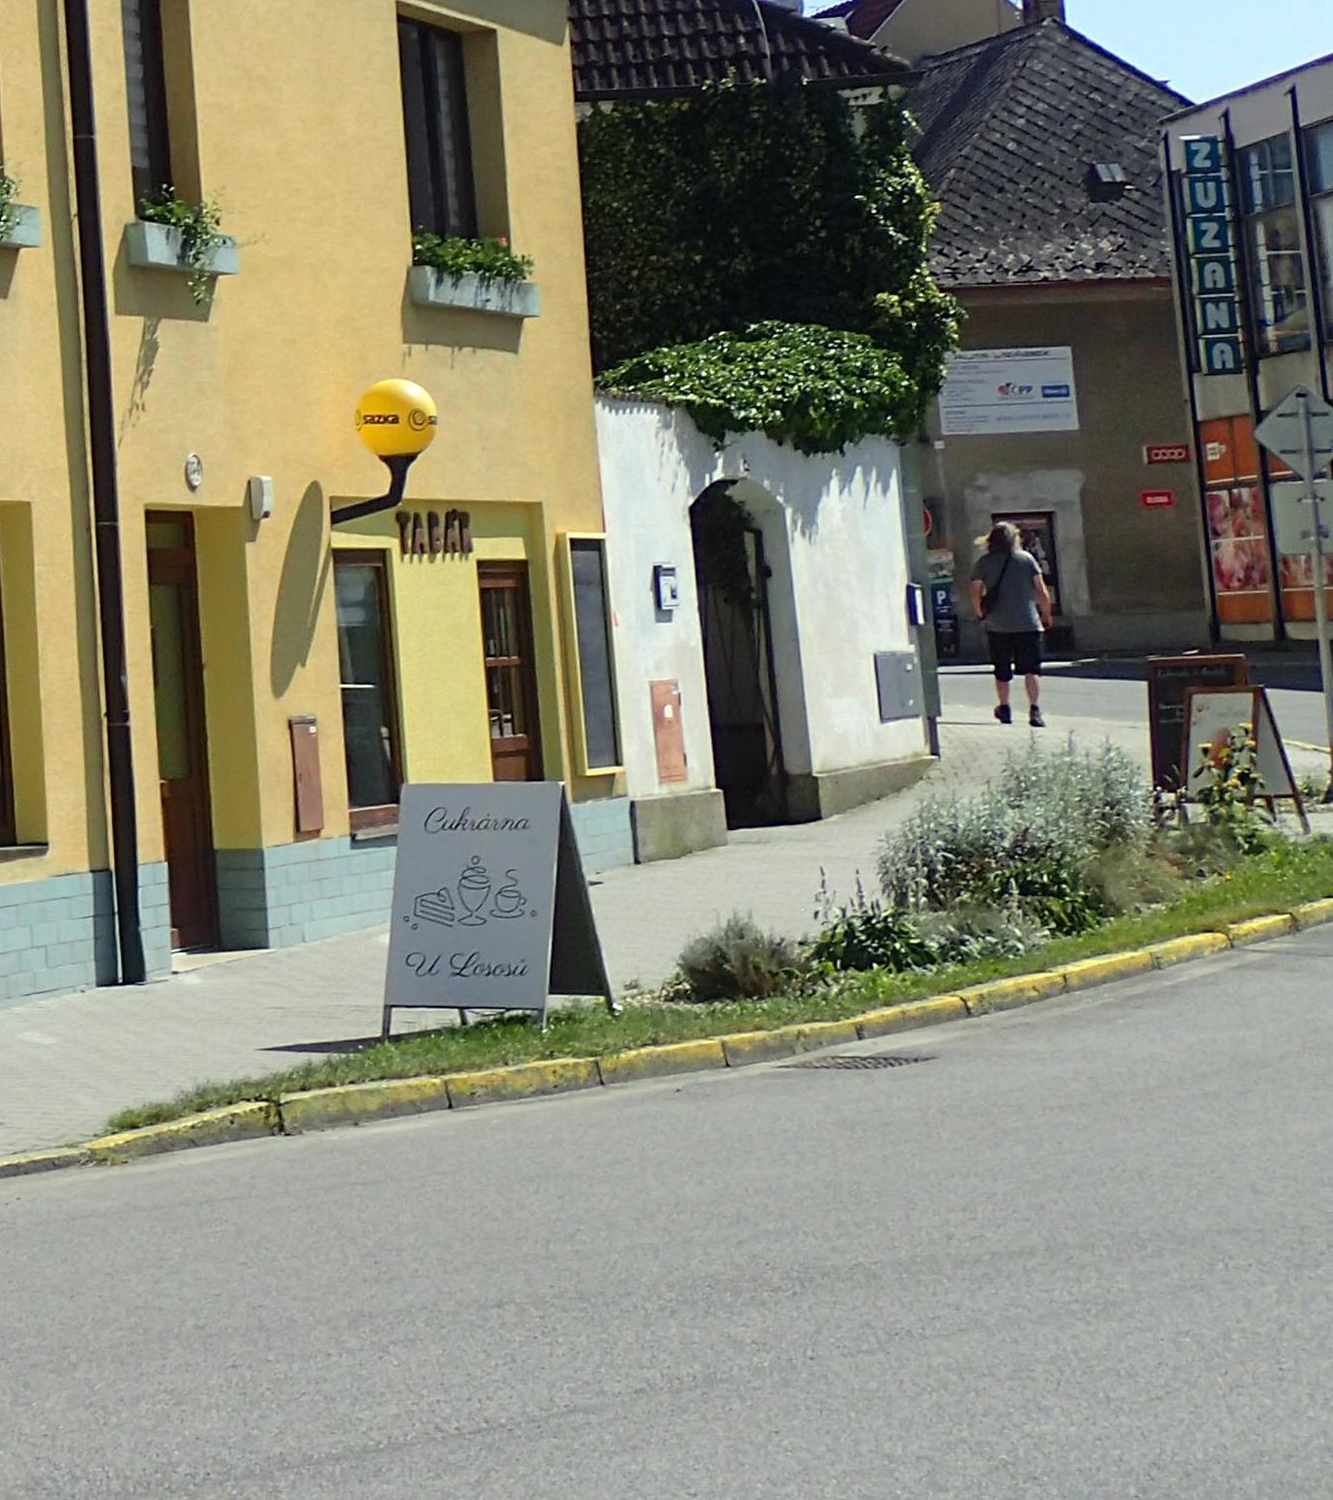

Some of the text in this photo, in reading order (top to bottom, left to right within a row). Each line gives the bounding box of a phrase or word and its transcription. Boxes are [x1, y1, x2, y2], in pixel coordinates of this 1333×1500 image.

[1190, 138, 1233, 371] ZUZANA
[424, 807, 530, 835] Cukrárna
[405, 950, 528, 979] U Lososů
